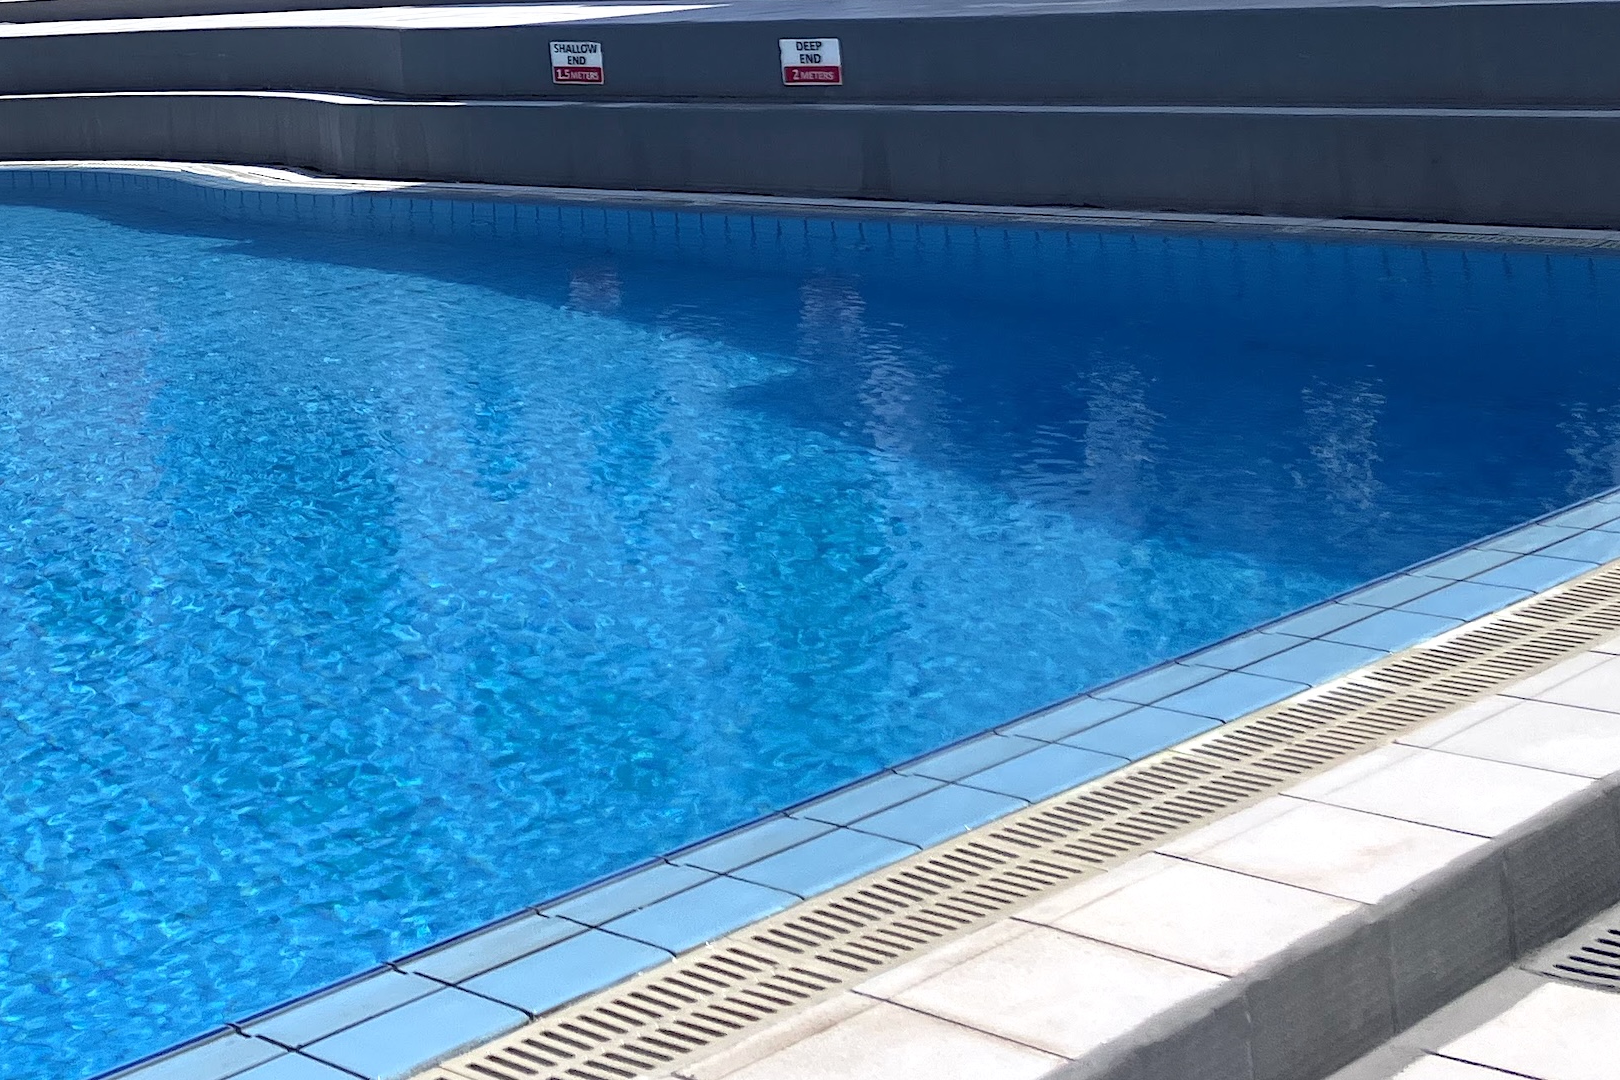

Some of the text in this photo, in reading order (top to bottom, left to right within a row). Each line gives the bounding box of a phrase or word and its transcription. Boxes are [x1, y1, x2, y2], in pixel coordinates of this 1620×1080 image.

[553, 43, 597, 54] SHALLOW
[796, 41, 822, 51] DEEP
[567, 55, 586, 65] END
[800, 53, 821, 64] END
[556, 69, 599, 80] 1.5 METERS
[792, 69, 834, 80] 2 METERS
